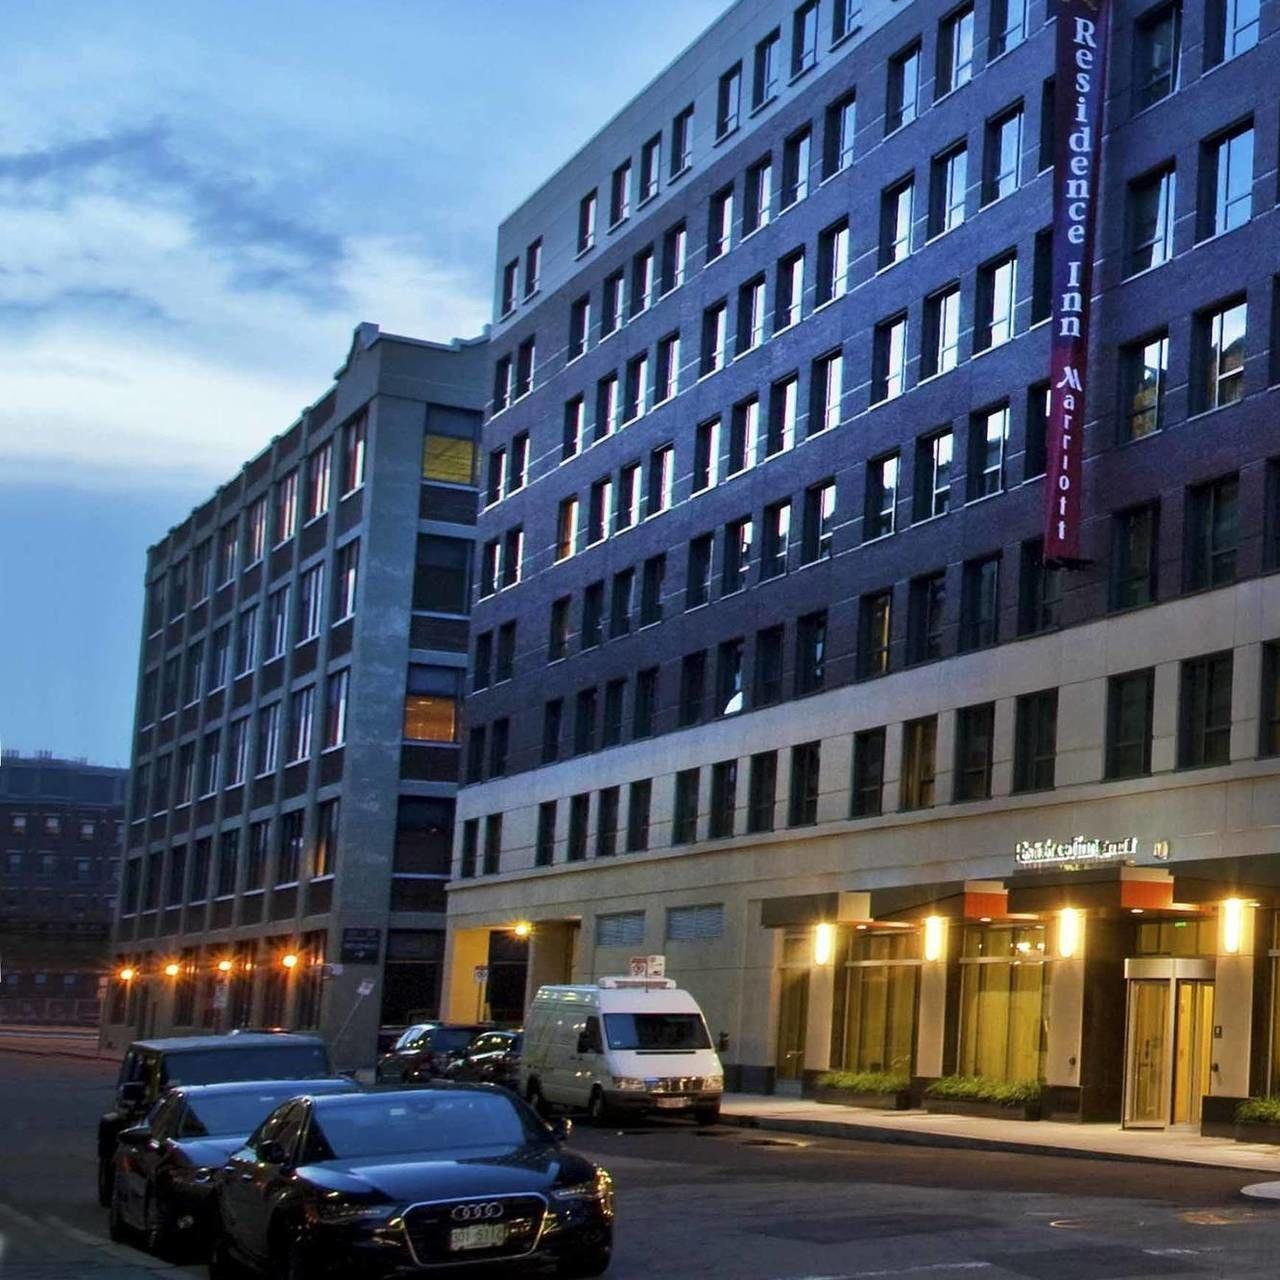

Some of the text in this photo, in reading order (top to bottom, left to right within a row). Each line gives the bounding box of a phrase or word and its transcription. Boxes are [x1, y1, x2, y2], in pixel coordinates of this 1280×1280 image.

[1056, 17, 1097, 539] Residence Inn Marriott
